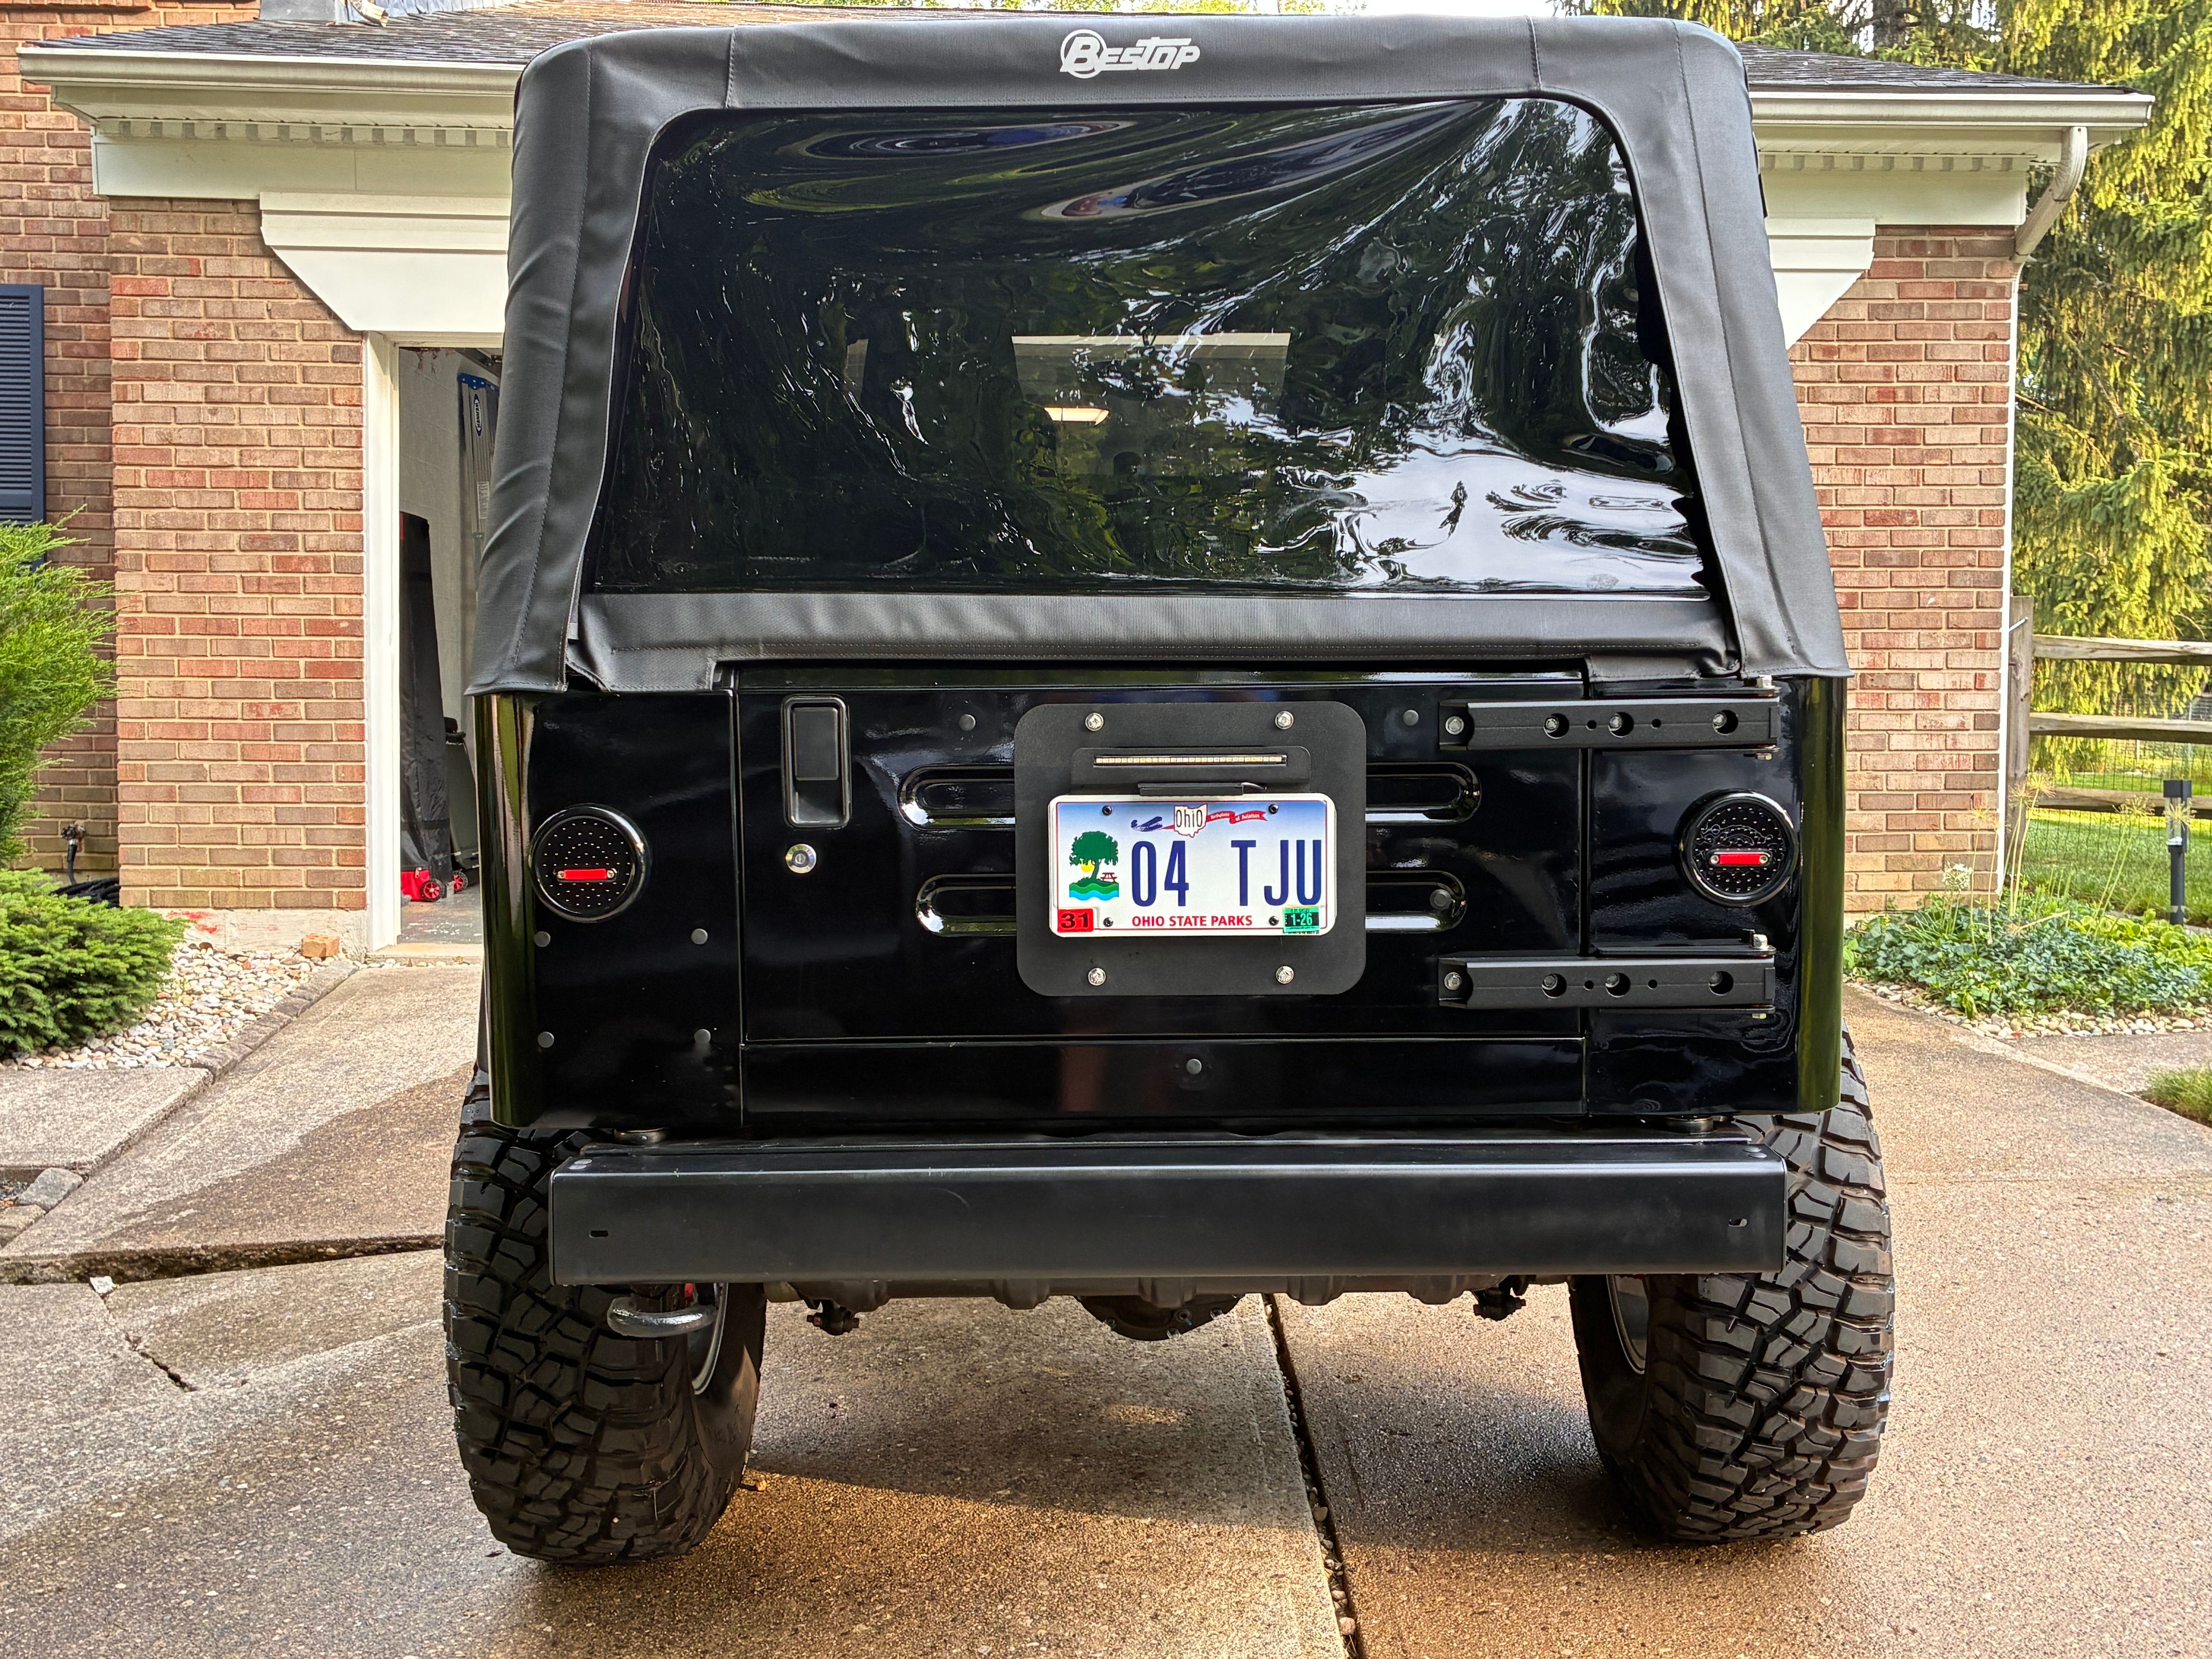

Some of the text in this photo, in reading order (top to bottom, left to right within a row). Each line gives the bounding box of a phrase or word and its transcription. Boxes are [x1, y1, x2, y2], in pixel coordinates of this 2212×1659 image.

[1132, 840, 1322, 907] 04 TJU
[1060, 913, 1089, 929] 31
[1132, 915, 1253, 927] OHIO STATE PARKS
[1291, 912, 1313, 926] 1-26
